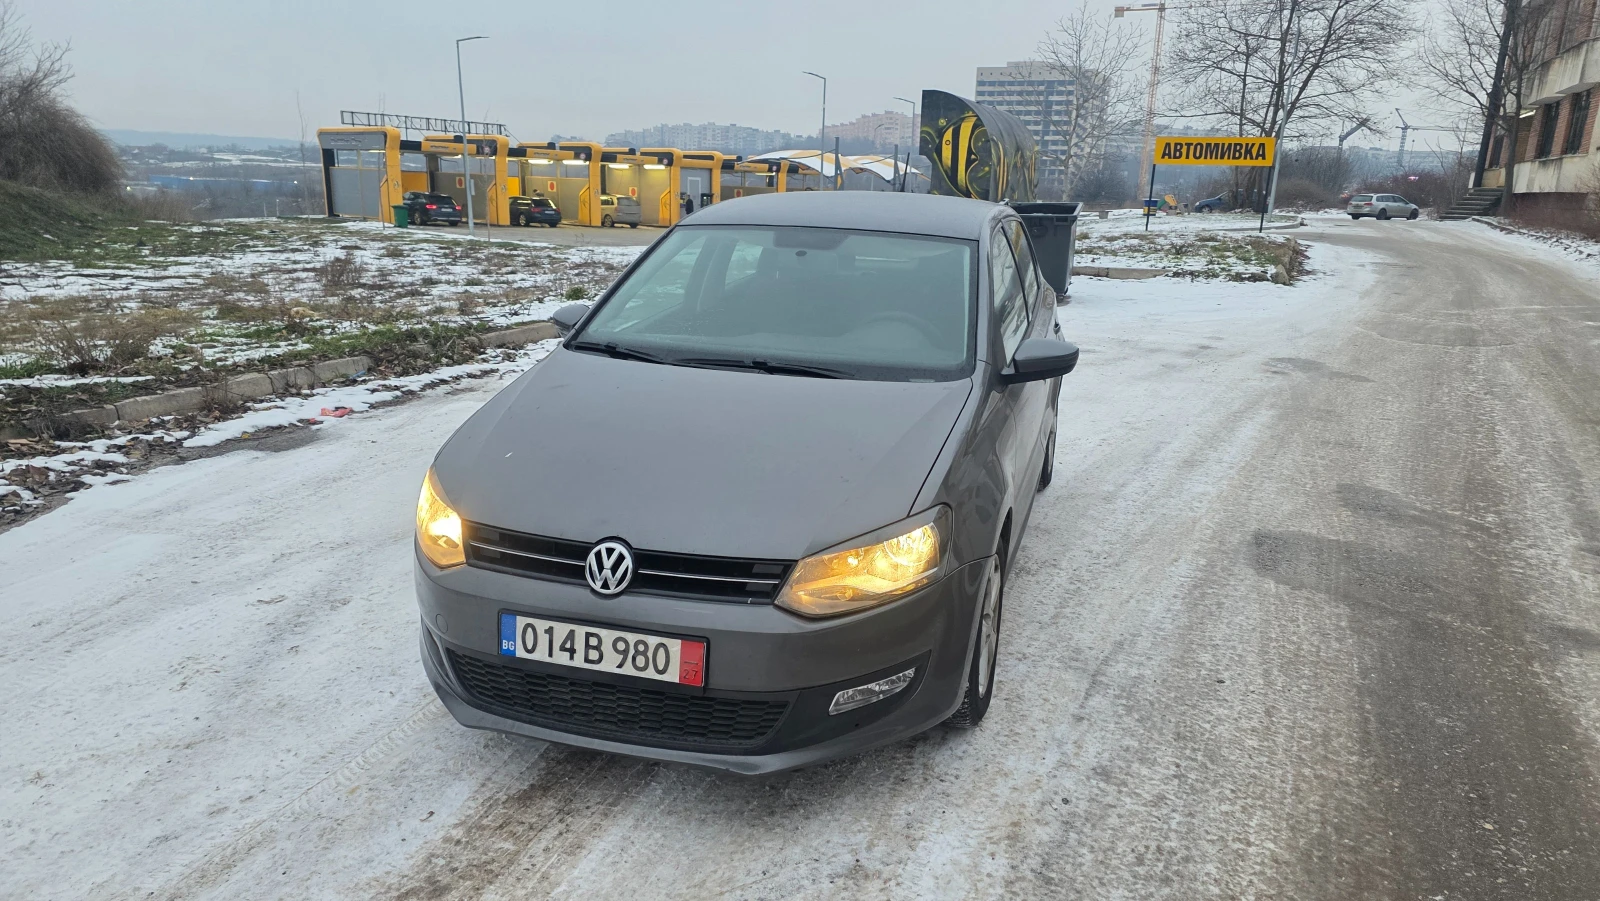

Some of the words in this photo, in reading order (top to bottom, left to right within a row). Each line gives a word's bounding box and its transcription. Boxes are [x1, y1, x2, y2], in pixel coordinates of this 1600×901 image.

[1161, 142, 1266, 160] АВТОМИВКА
[502, 639, 514, 650] BG
[683, 668, 698, 680] 27
